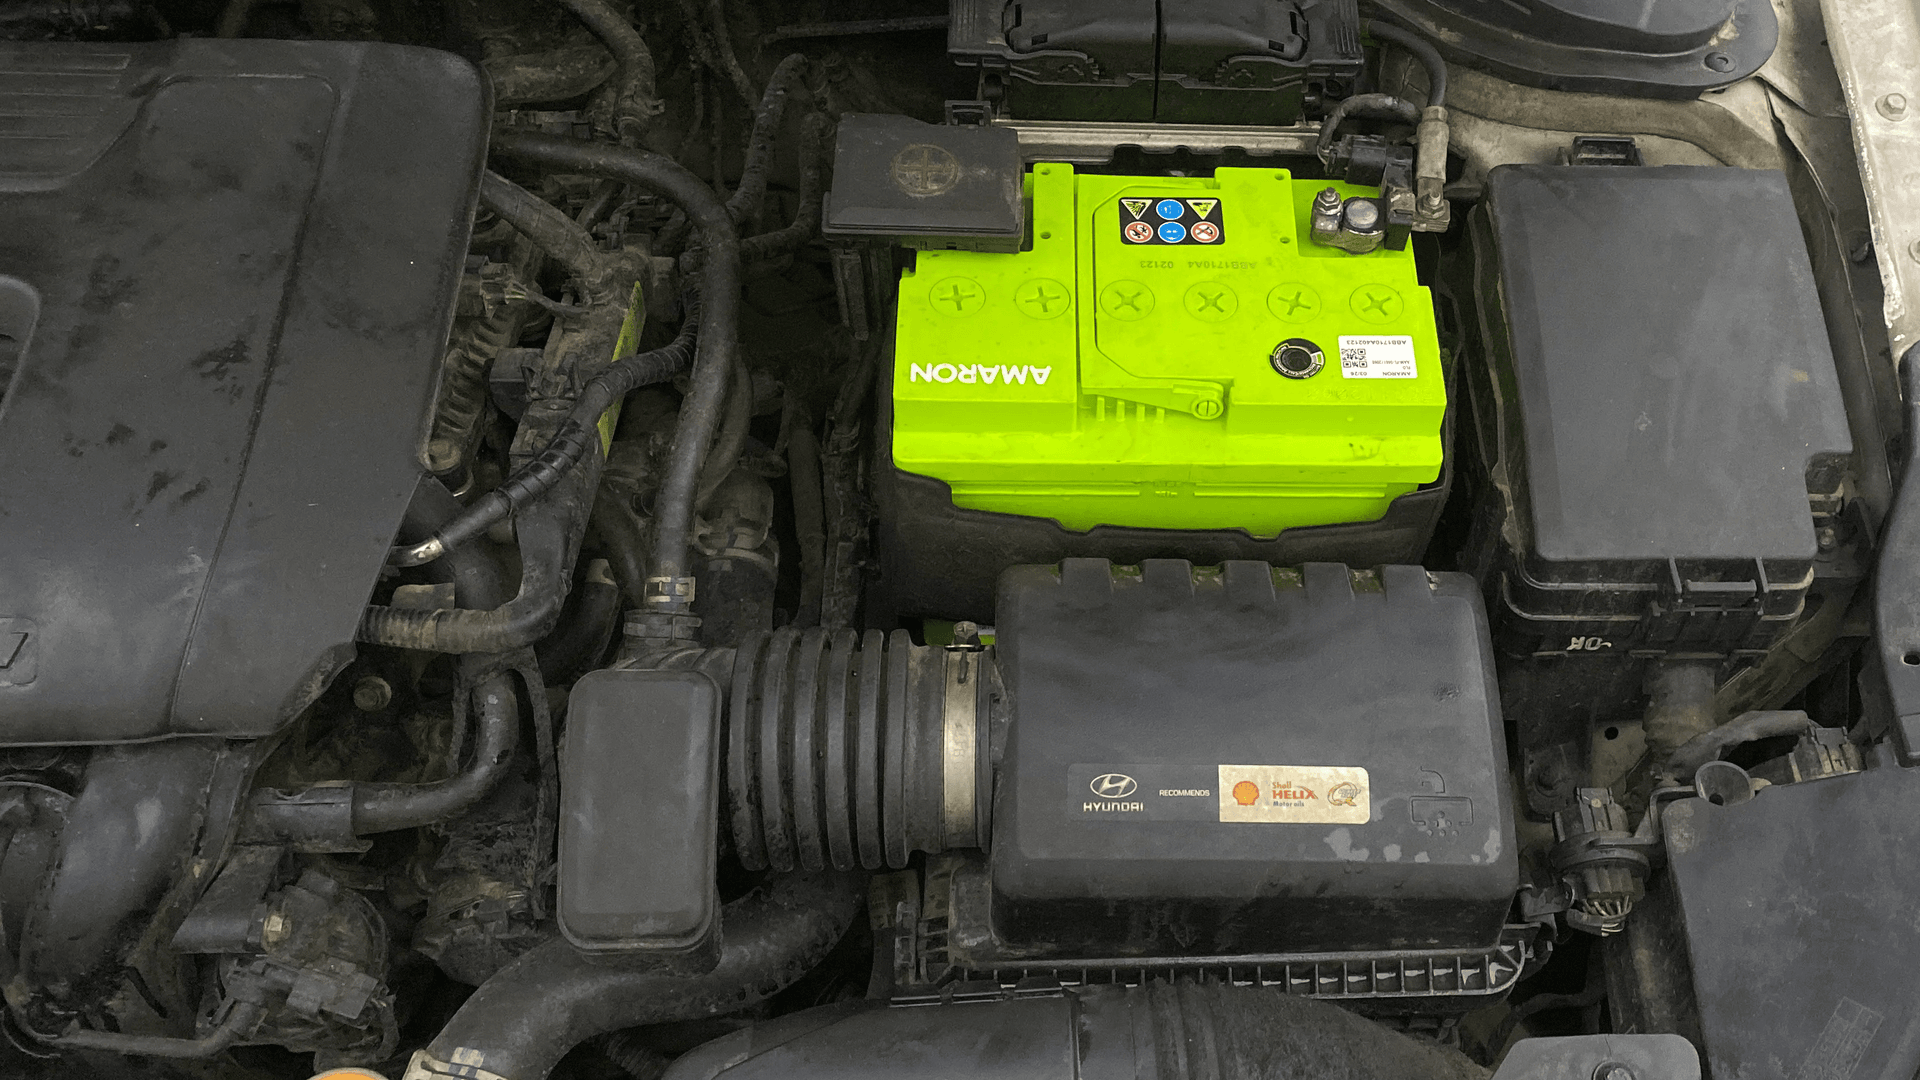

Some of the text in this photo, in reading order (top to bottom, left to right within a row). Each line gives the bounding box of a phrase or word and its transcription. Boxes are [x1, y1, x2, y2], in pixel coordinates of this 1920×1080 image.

[1140, 260, 1174, 269] 02123
[910, 362, 1052, 385] AMARON
[1272, 781, 1292, 789] Shell
[1158, 789, 1211, 797] RECOMMENDS
[1272, 789, 1319, 800] HELIX
[1083, 801, 1145, 812] HYUNDAI
